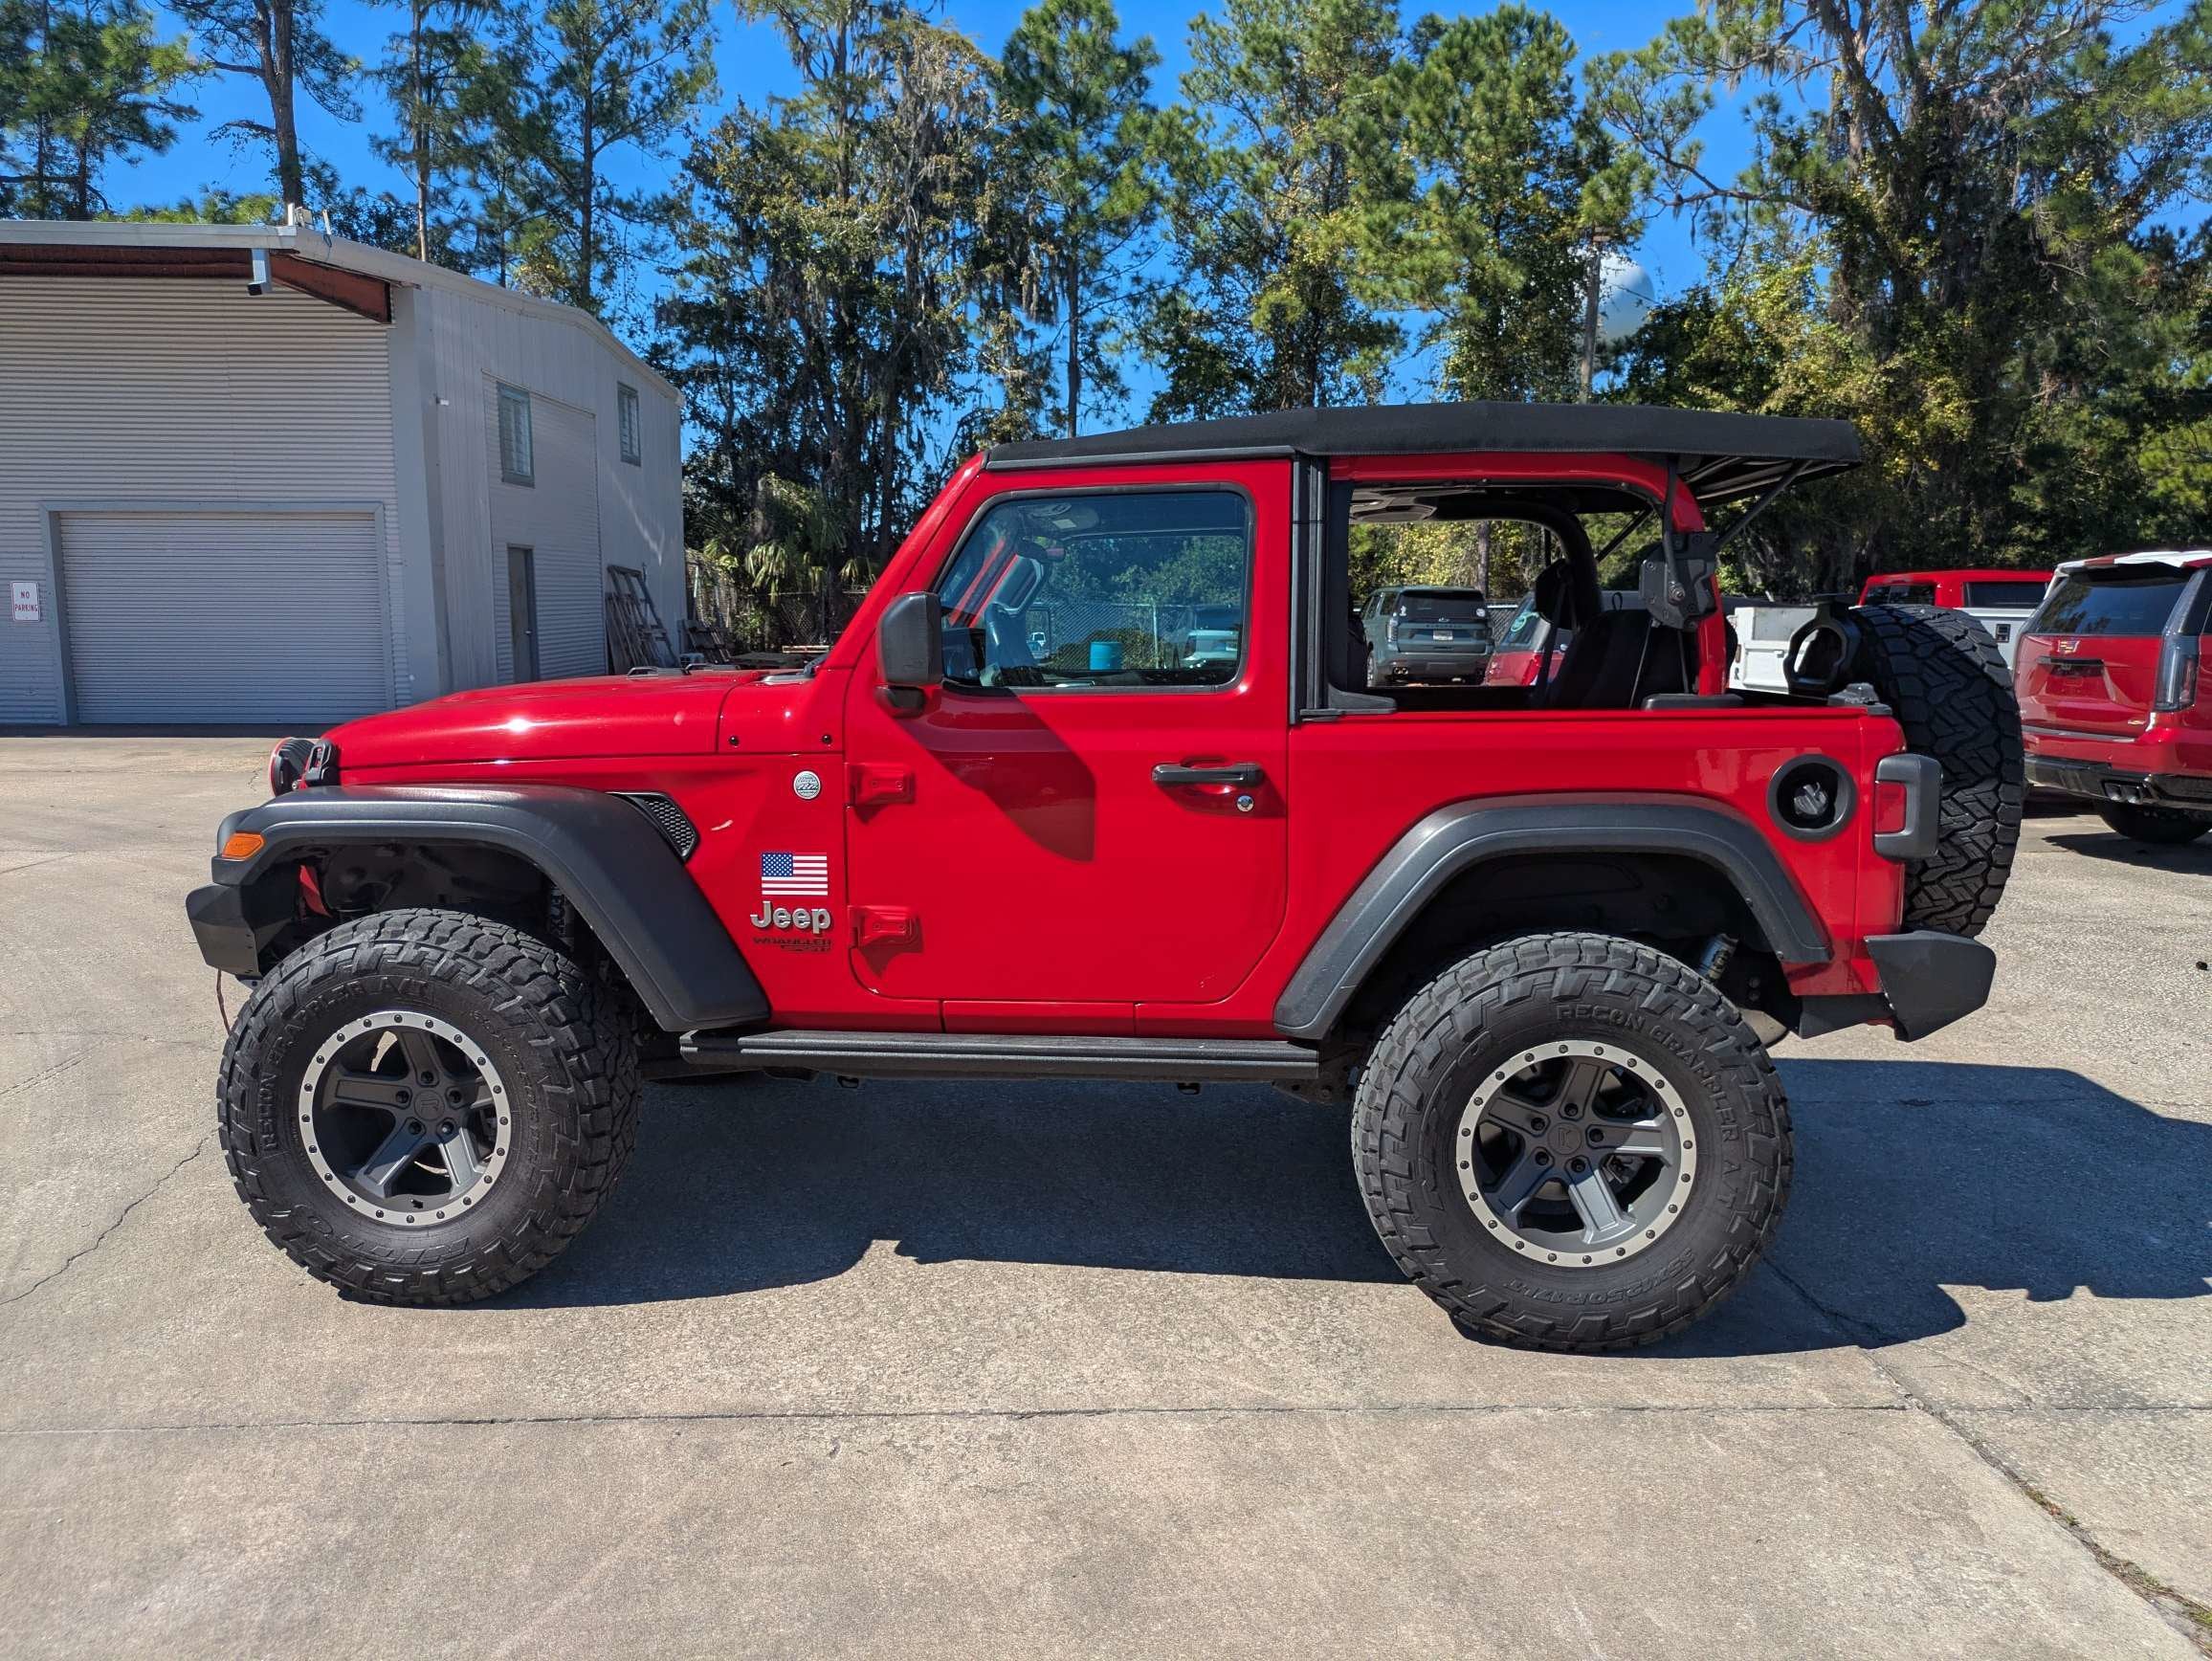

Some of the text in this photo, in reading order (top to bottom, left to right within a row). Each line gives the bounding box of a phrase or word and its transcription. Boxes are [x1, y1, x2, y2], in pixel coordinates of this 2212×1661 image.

[20, 590, 31, 599] NO
[14, 604, 38, 612] PARKING
[750, 900, 831, 935] Jeep
